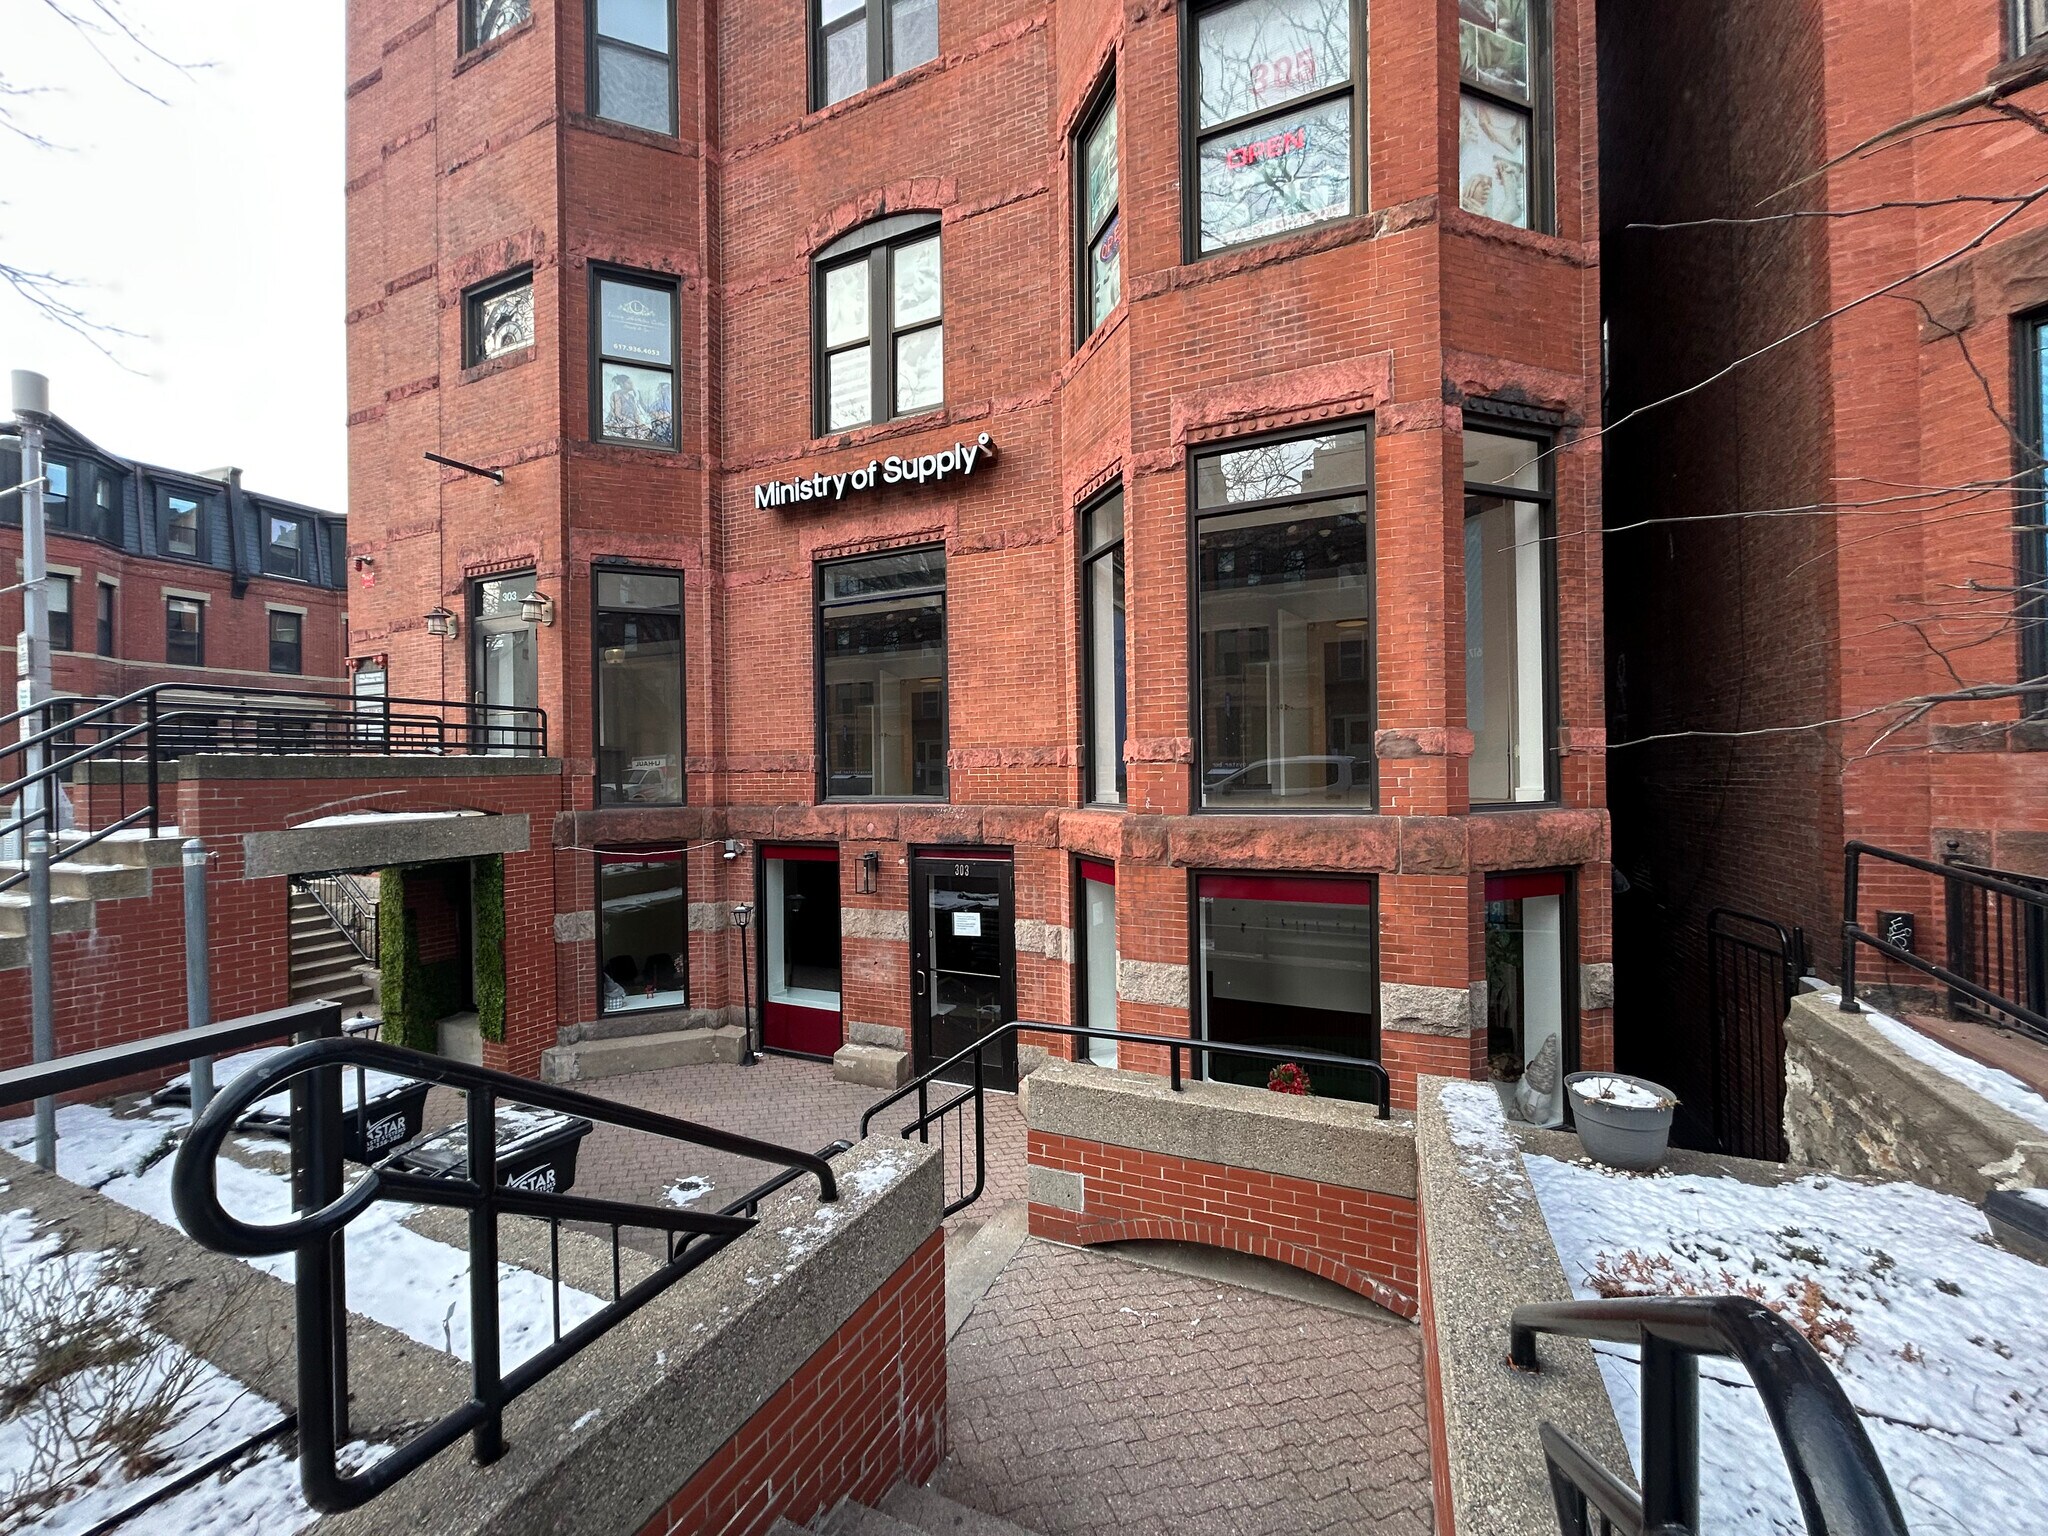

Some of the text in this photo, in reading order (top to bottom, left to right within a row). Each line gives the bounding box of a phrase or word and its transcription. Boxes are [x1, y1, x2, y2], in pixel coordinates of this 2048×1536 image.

[1226, 127, 1305, 170] OPEN
[754, 471, 847, 509] Ministry
[851, 460, 877, 490] of
[502, 591, 517, 602] 303
[954, 864, 970, 877] 303
